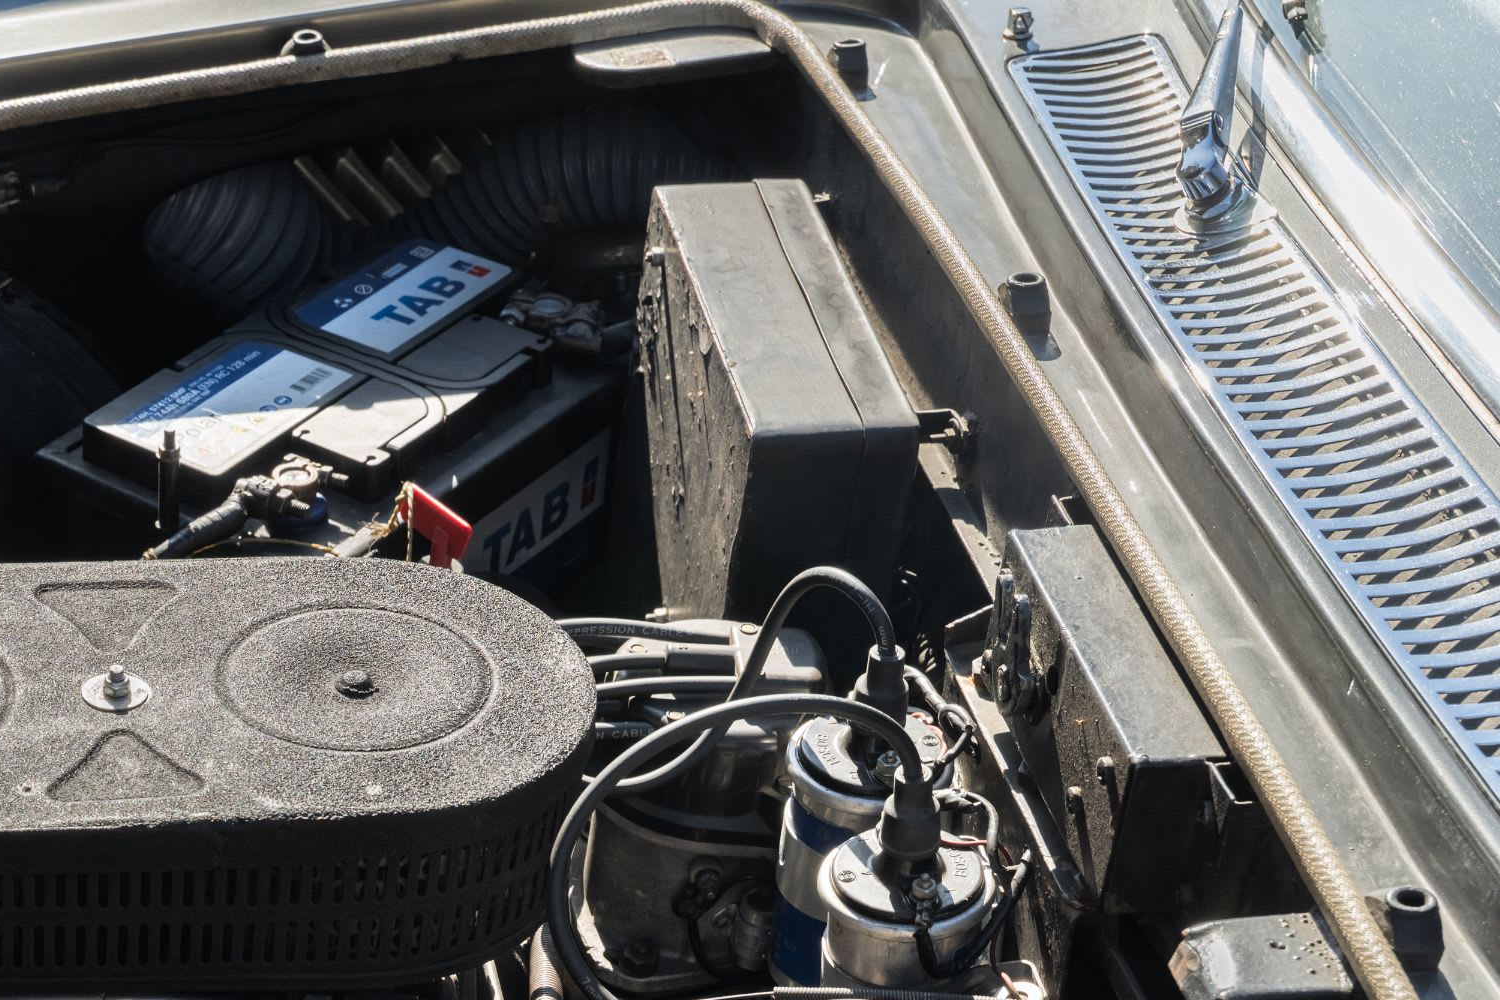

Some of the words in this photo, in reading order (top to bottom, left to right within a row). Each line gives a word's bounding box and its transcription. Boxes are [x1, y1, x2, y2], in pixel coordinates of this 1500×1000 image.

[371, 275, 465, 325] TAB
[483, 480, 570, 575] TAB
[815, 733, 841, 767] BOSCH
